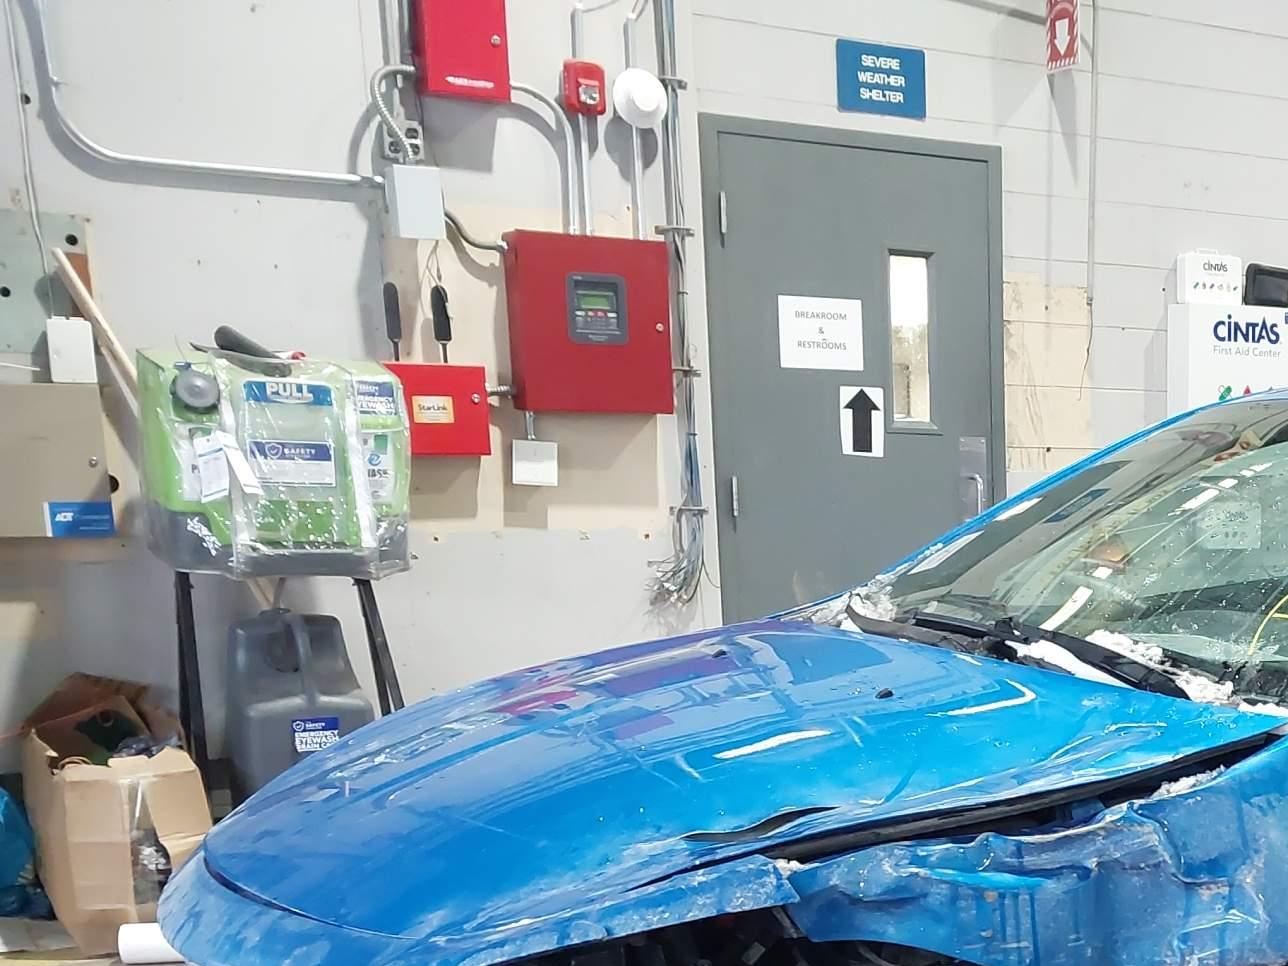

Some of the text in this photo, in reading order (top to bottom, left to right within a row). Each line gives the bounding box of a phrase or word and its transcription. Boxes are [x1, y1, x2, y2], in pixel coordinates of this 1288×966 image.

[861, 54, 900, 70] SEVERE
[857, 71, 906, 87] WEATHER
[860, 87, 904, 104] SHELTER
[794, 310, 847, 321] BREAKROOM
[818, 326, 825, 335] &
[797, 340, 847, 351] RESTROOMS
[1213, 345, 1281, 358] First Aid Center
[266, 381, 313, 399] PULL
[417, 403, 449, 411] StarLink
[284, 447, 317, 456] SAFETY
[295, 730, 340, 738] EMERGENCY
[295, 736, 340, 746] EYEWASH
